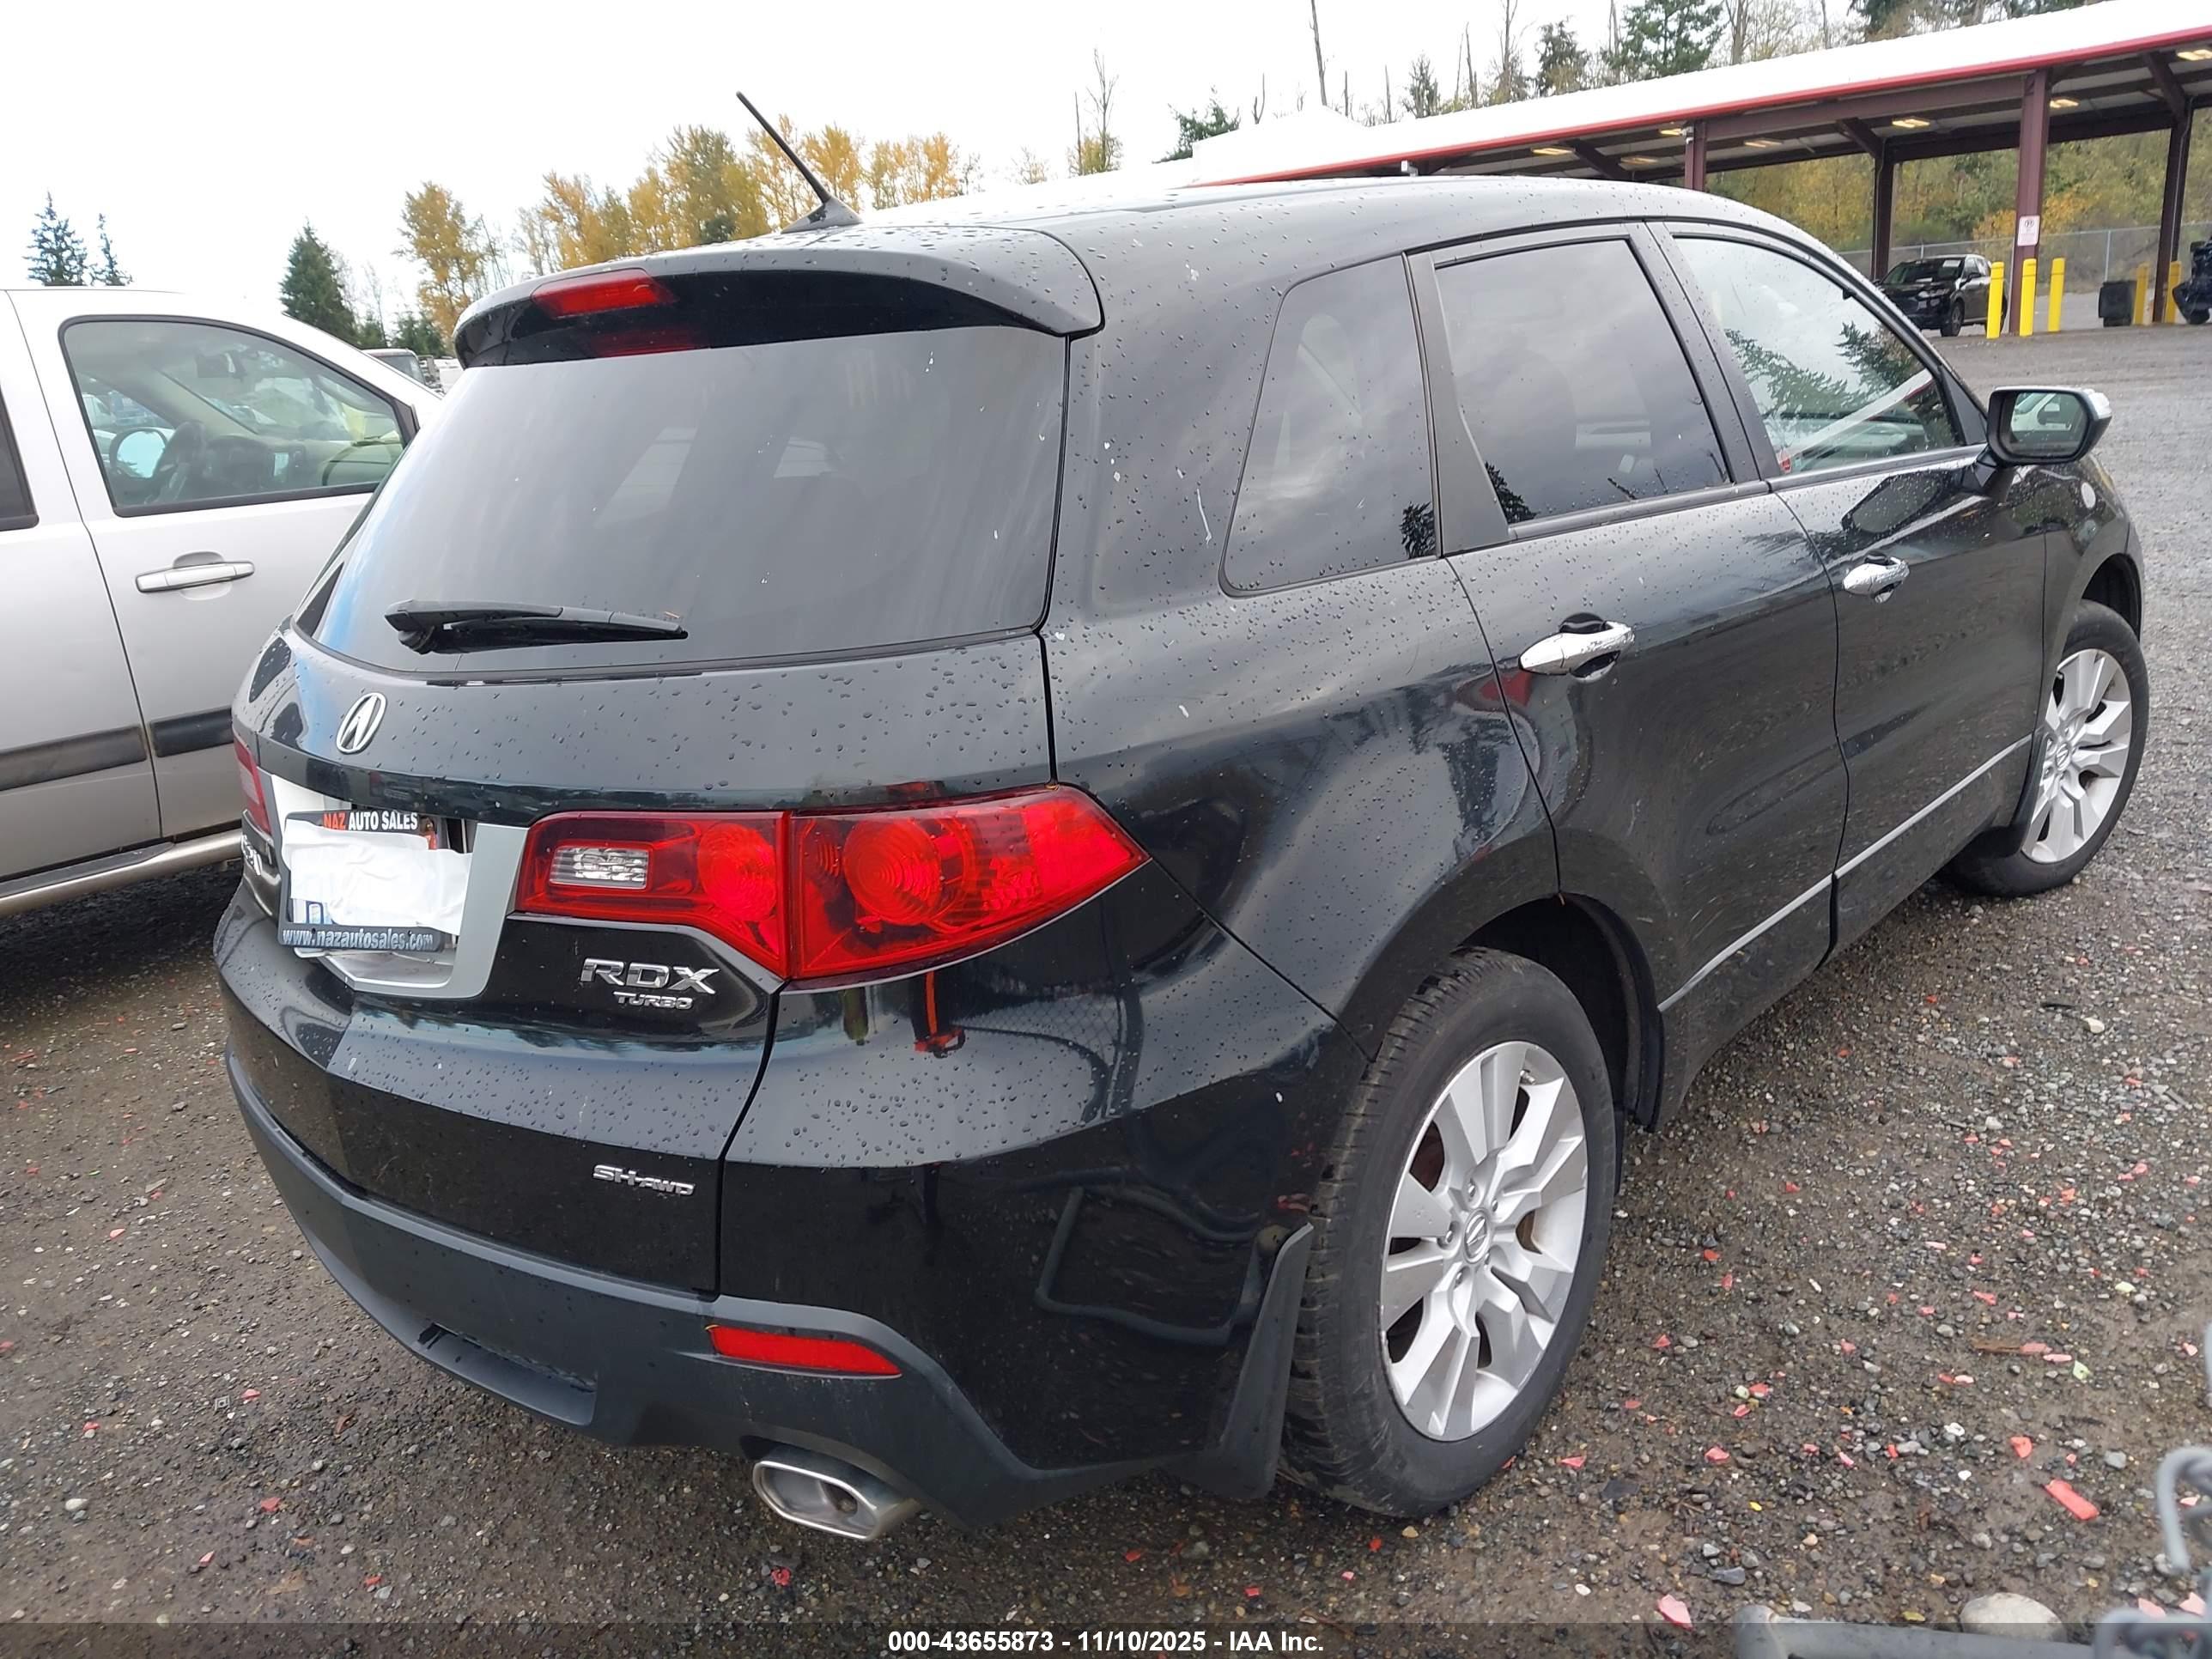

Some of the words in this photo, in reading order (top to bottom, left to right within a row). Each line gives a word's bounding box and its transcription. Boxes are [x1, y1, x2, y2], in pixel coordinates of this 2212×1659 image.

[323, 811, 347, 830] NAZ
[348, 811, 379, 831] AUTO
[381, 811, 418, 830] SALES
[283, 927, 434, 951] www.nazautosales.com
[580, 957, 720, 994] RDX
[613, 991, 693, 1010] TURBO
[592, 1164, 695, 1195] SH-AWD
